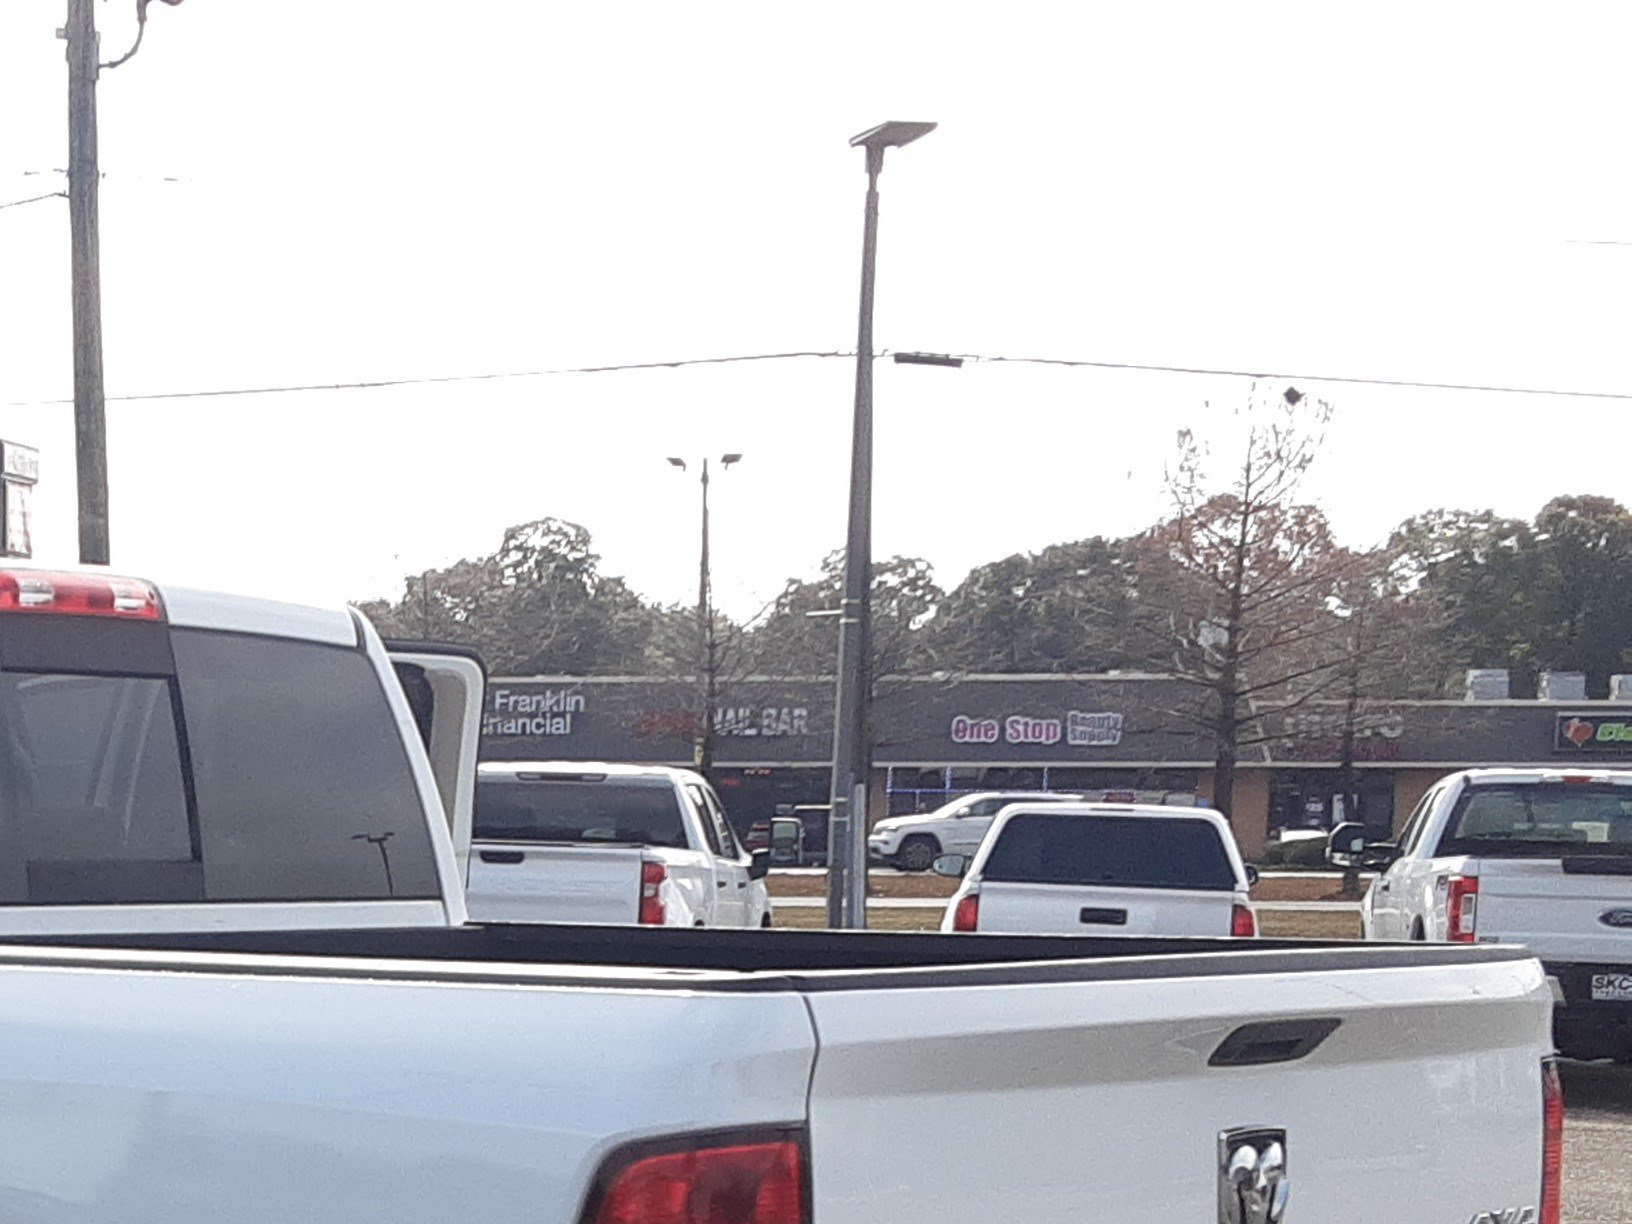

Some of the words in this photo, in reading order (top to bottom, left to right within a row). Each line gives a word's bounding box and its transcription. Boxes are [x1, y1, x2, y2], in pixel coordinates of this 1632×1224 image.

[495, 689, 585, 712] Franklin
[481, 712, 571, 734] inancial
[762, 707, 808, 735] BAR
[954, 717, 998, 740] One
[1008, 717, 1059, 742] Stop
[1593, 976, 1632, 990] SKC
